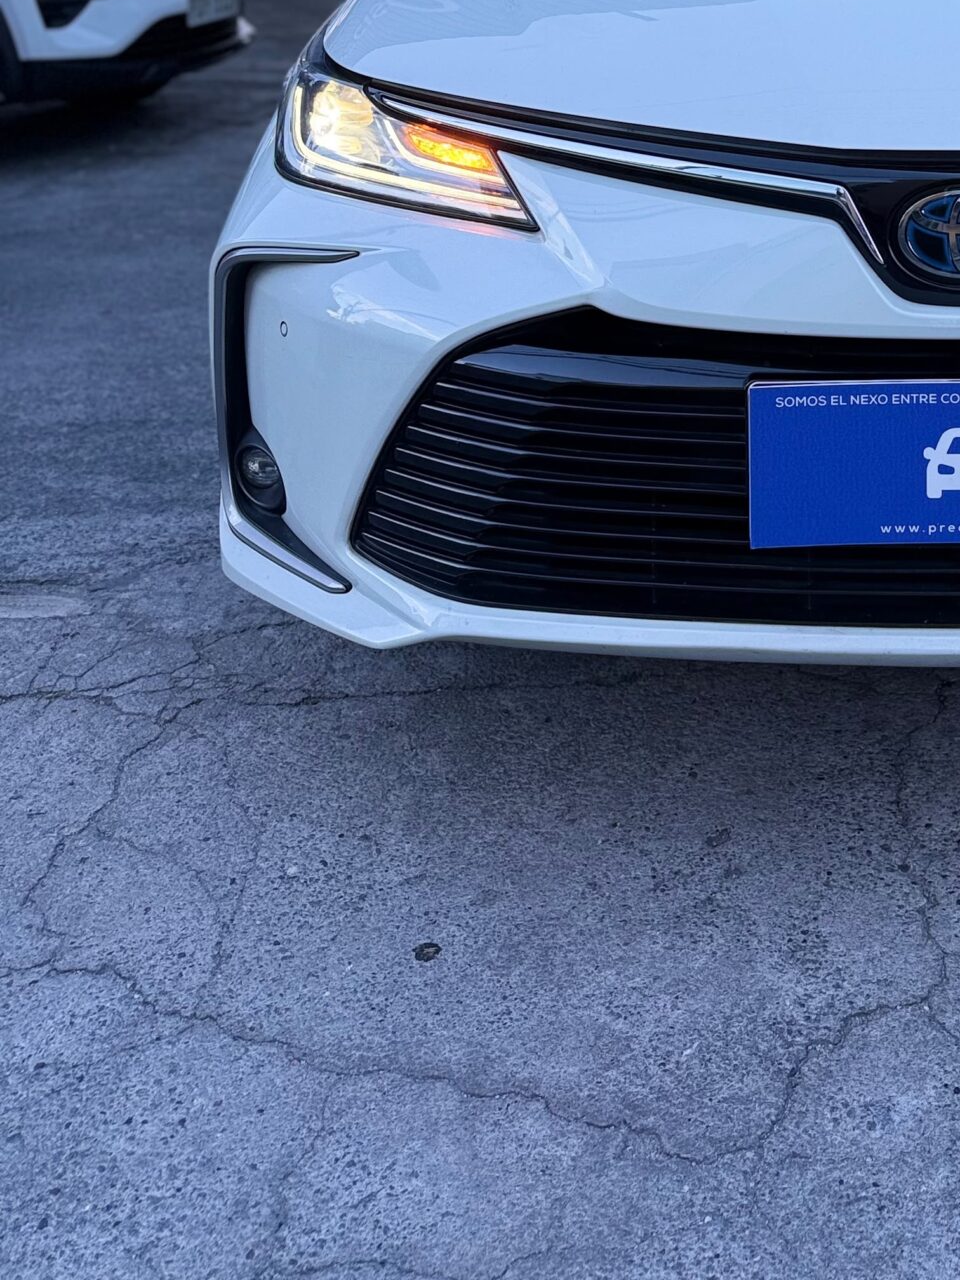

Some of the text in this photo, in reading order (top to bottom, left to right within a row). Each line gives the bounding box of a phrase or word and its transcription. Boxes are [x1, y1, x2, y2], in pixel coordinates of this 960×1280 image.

[775, 395, 827, 408] SOMOS
[830, 395, 847, 406] EL
[850, 394, 888, 406] NEXO
[892, 393, 937, 404] ENTRE
